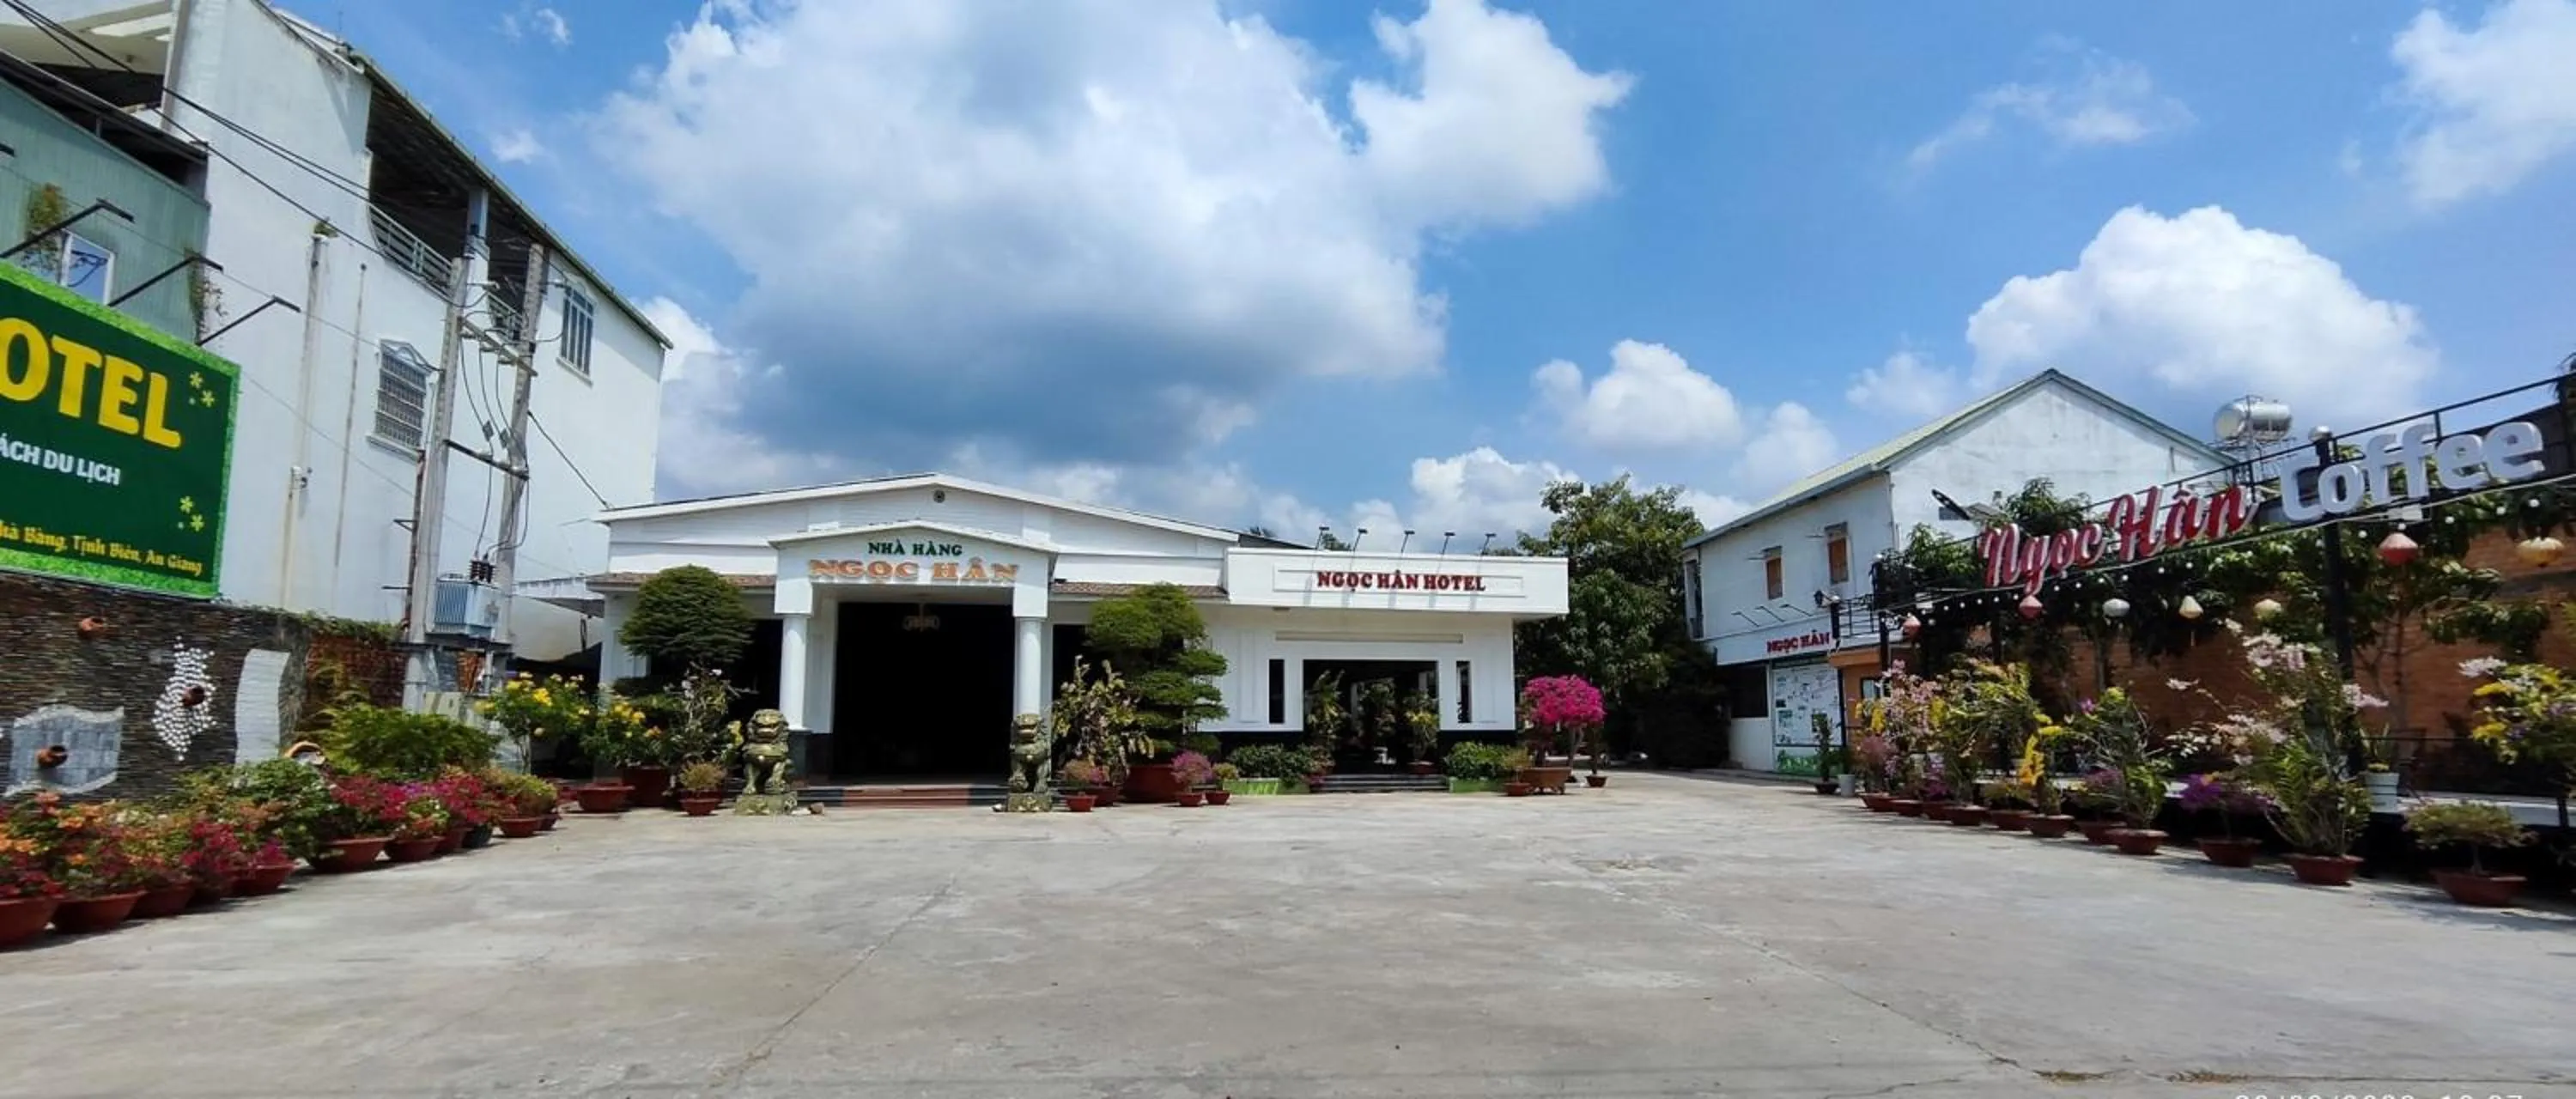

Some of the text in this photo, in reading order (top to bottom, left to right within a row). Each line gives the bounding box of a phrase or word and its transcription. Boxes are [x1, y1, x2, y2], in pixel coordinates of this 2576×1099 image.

[0, 317, 182, 449] OTEL
[43, 449, 74, 473] DU
[76, 458, 121, 486] LỊCH
[1978, 422, 2545, 597] Ngọc Hân Coffee
[868, 538, 962, 556] NHÀ HÀNG
[167, 555, 202, 577] Giang
[931, 556, 1019, 581] HÂN
[1316, 569, 1486, 592] NGỌC HÂN HOTEL
